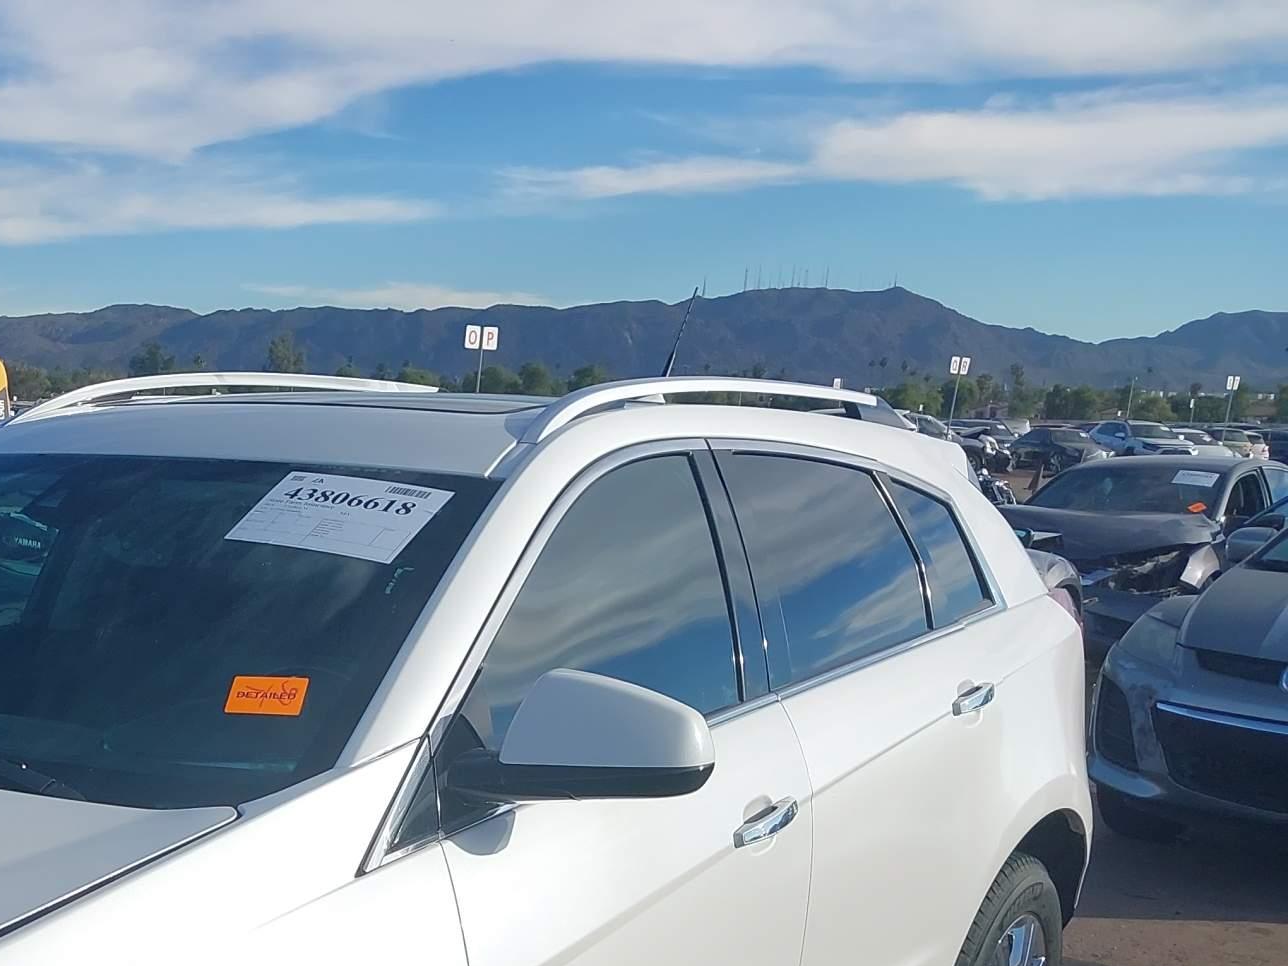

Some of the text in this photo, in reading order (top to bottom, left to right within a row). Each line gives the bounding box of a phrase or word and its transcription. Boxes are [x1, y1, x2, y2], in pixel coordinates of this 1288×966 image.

[487, 331, 494, 346] P
[284, 486, 417, 517] 43806618
[15, 537, 41, 550] YAMAHA
[236, 690, 297, 701] DETAILED
